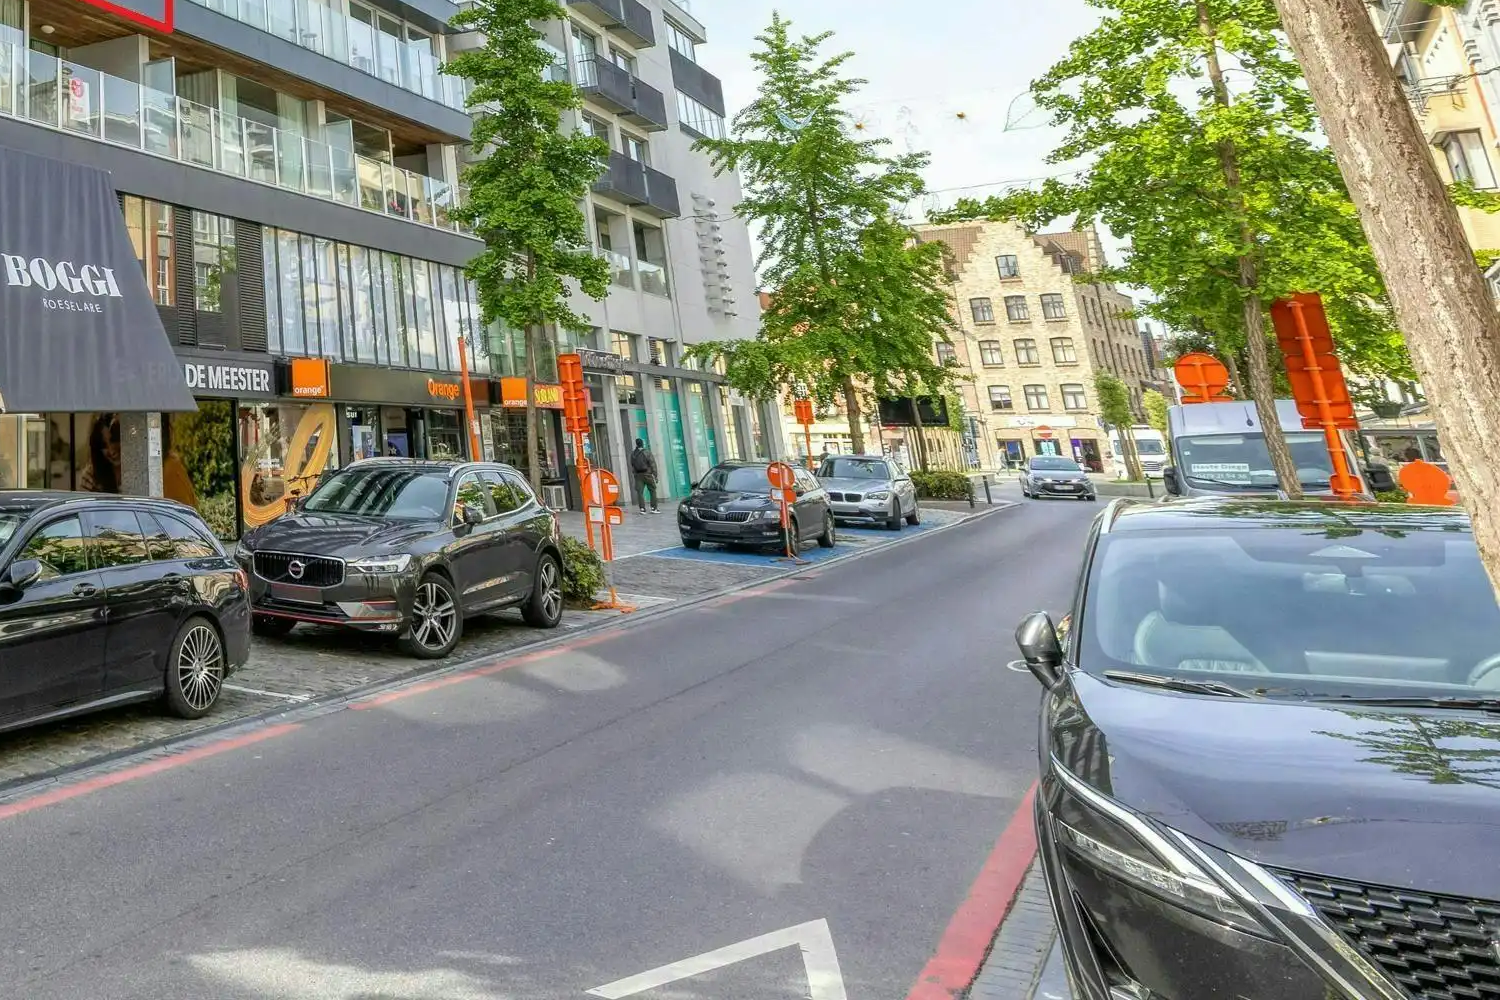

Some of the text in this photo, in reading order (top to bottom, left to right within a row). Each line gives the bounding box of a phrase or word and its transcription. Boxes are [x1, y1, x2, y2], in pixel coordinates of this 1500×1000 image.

[0, 252, 123, 298] BOGGI
[42, 298, 103, 313] ROESELARE
[184, 363, 206, 389] DE
[208, 365, 270, 392] MEESTER
[427, 377, 461, 400] Orange
[294, 386, 324, 395] orange
